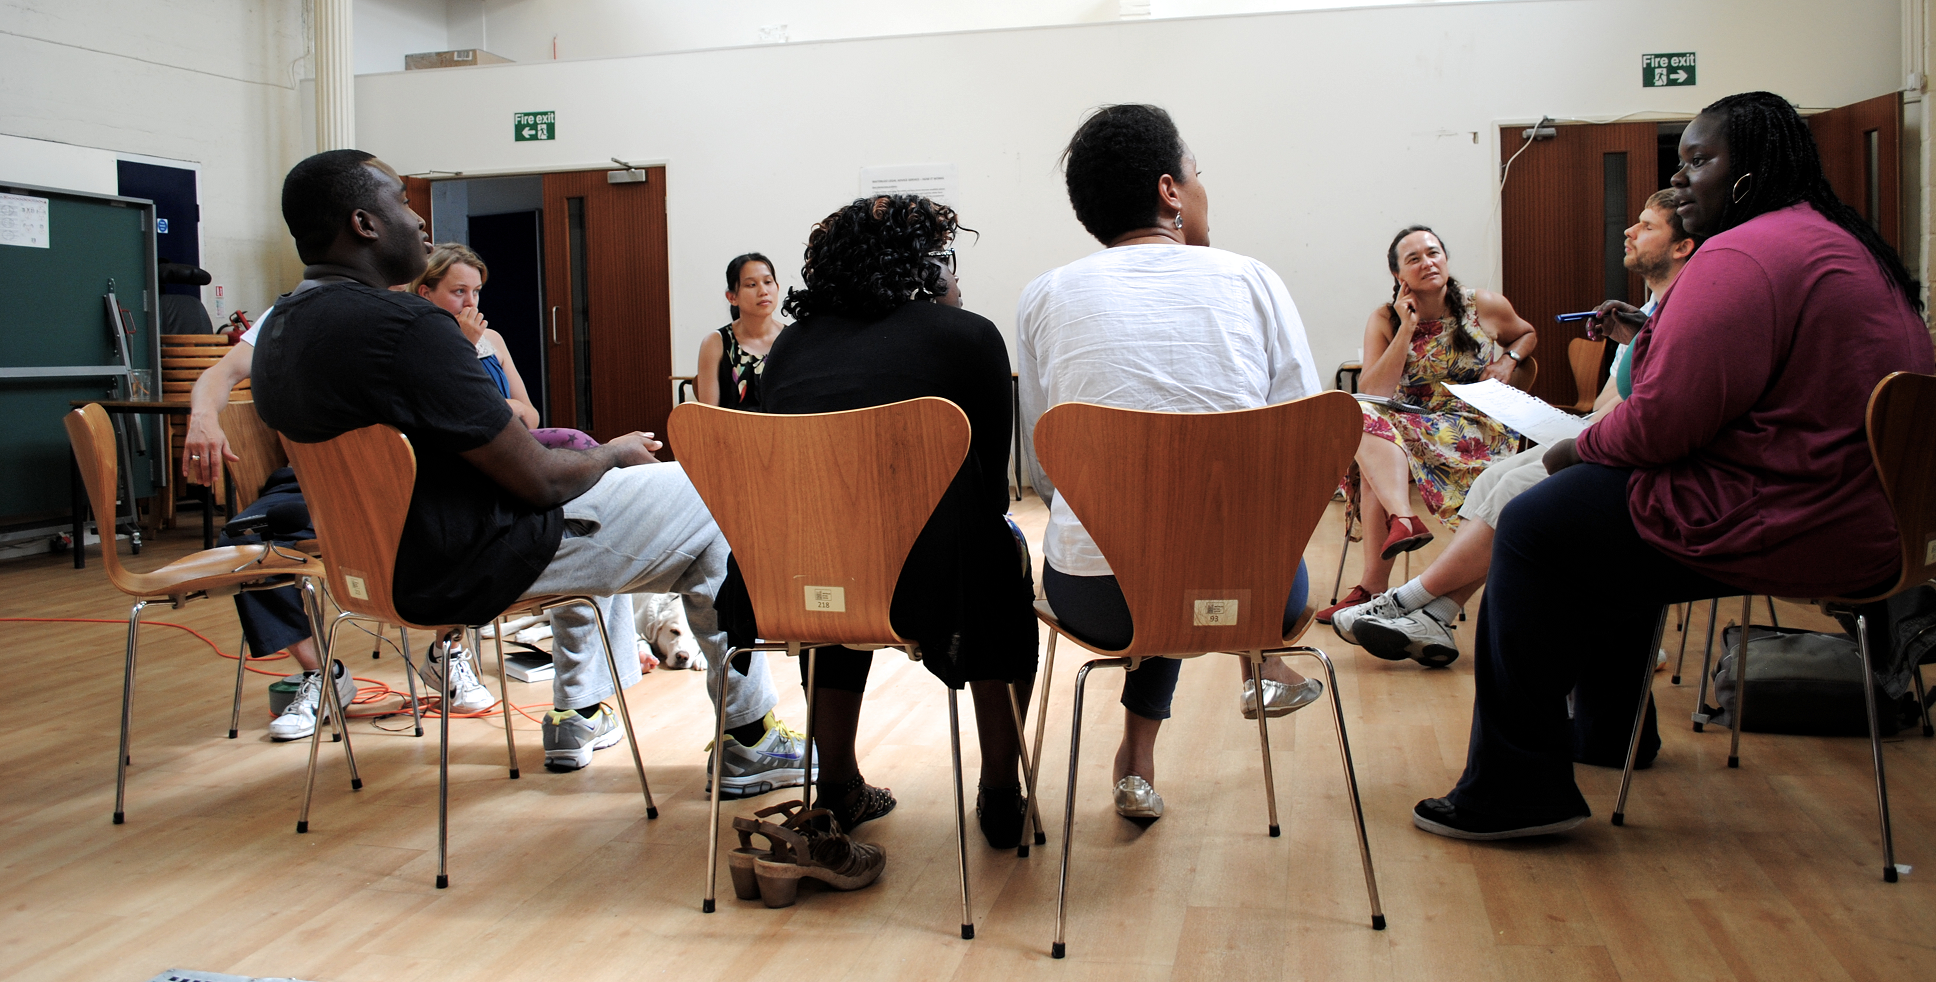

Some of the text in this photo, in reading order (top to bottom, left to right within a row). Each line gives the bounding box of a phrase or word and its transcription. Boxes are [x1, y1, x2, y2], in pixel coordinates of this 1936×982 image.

[1643, 53, 1695, 68] Fire exit
[515, 112, 555, 125] Fire exit
